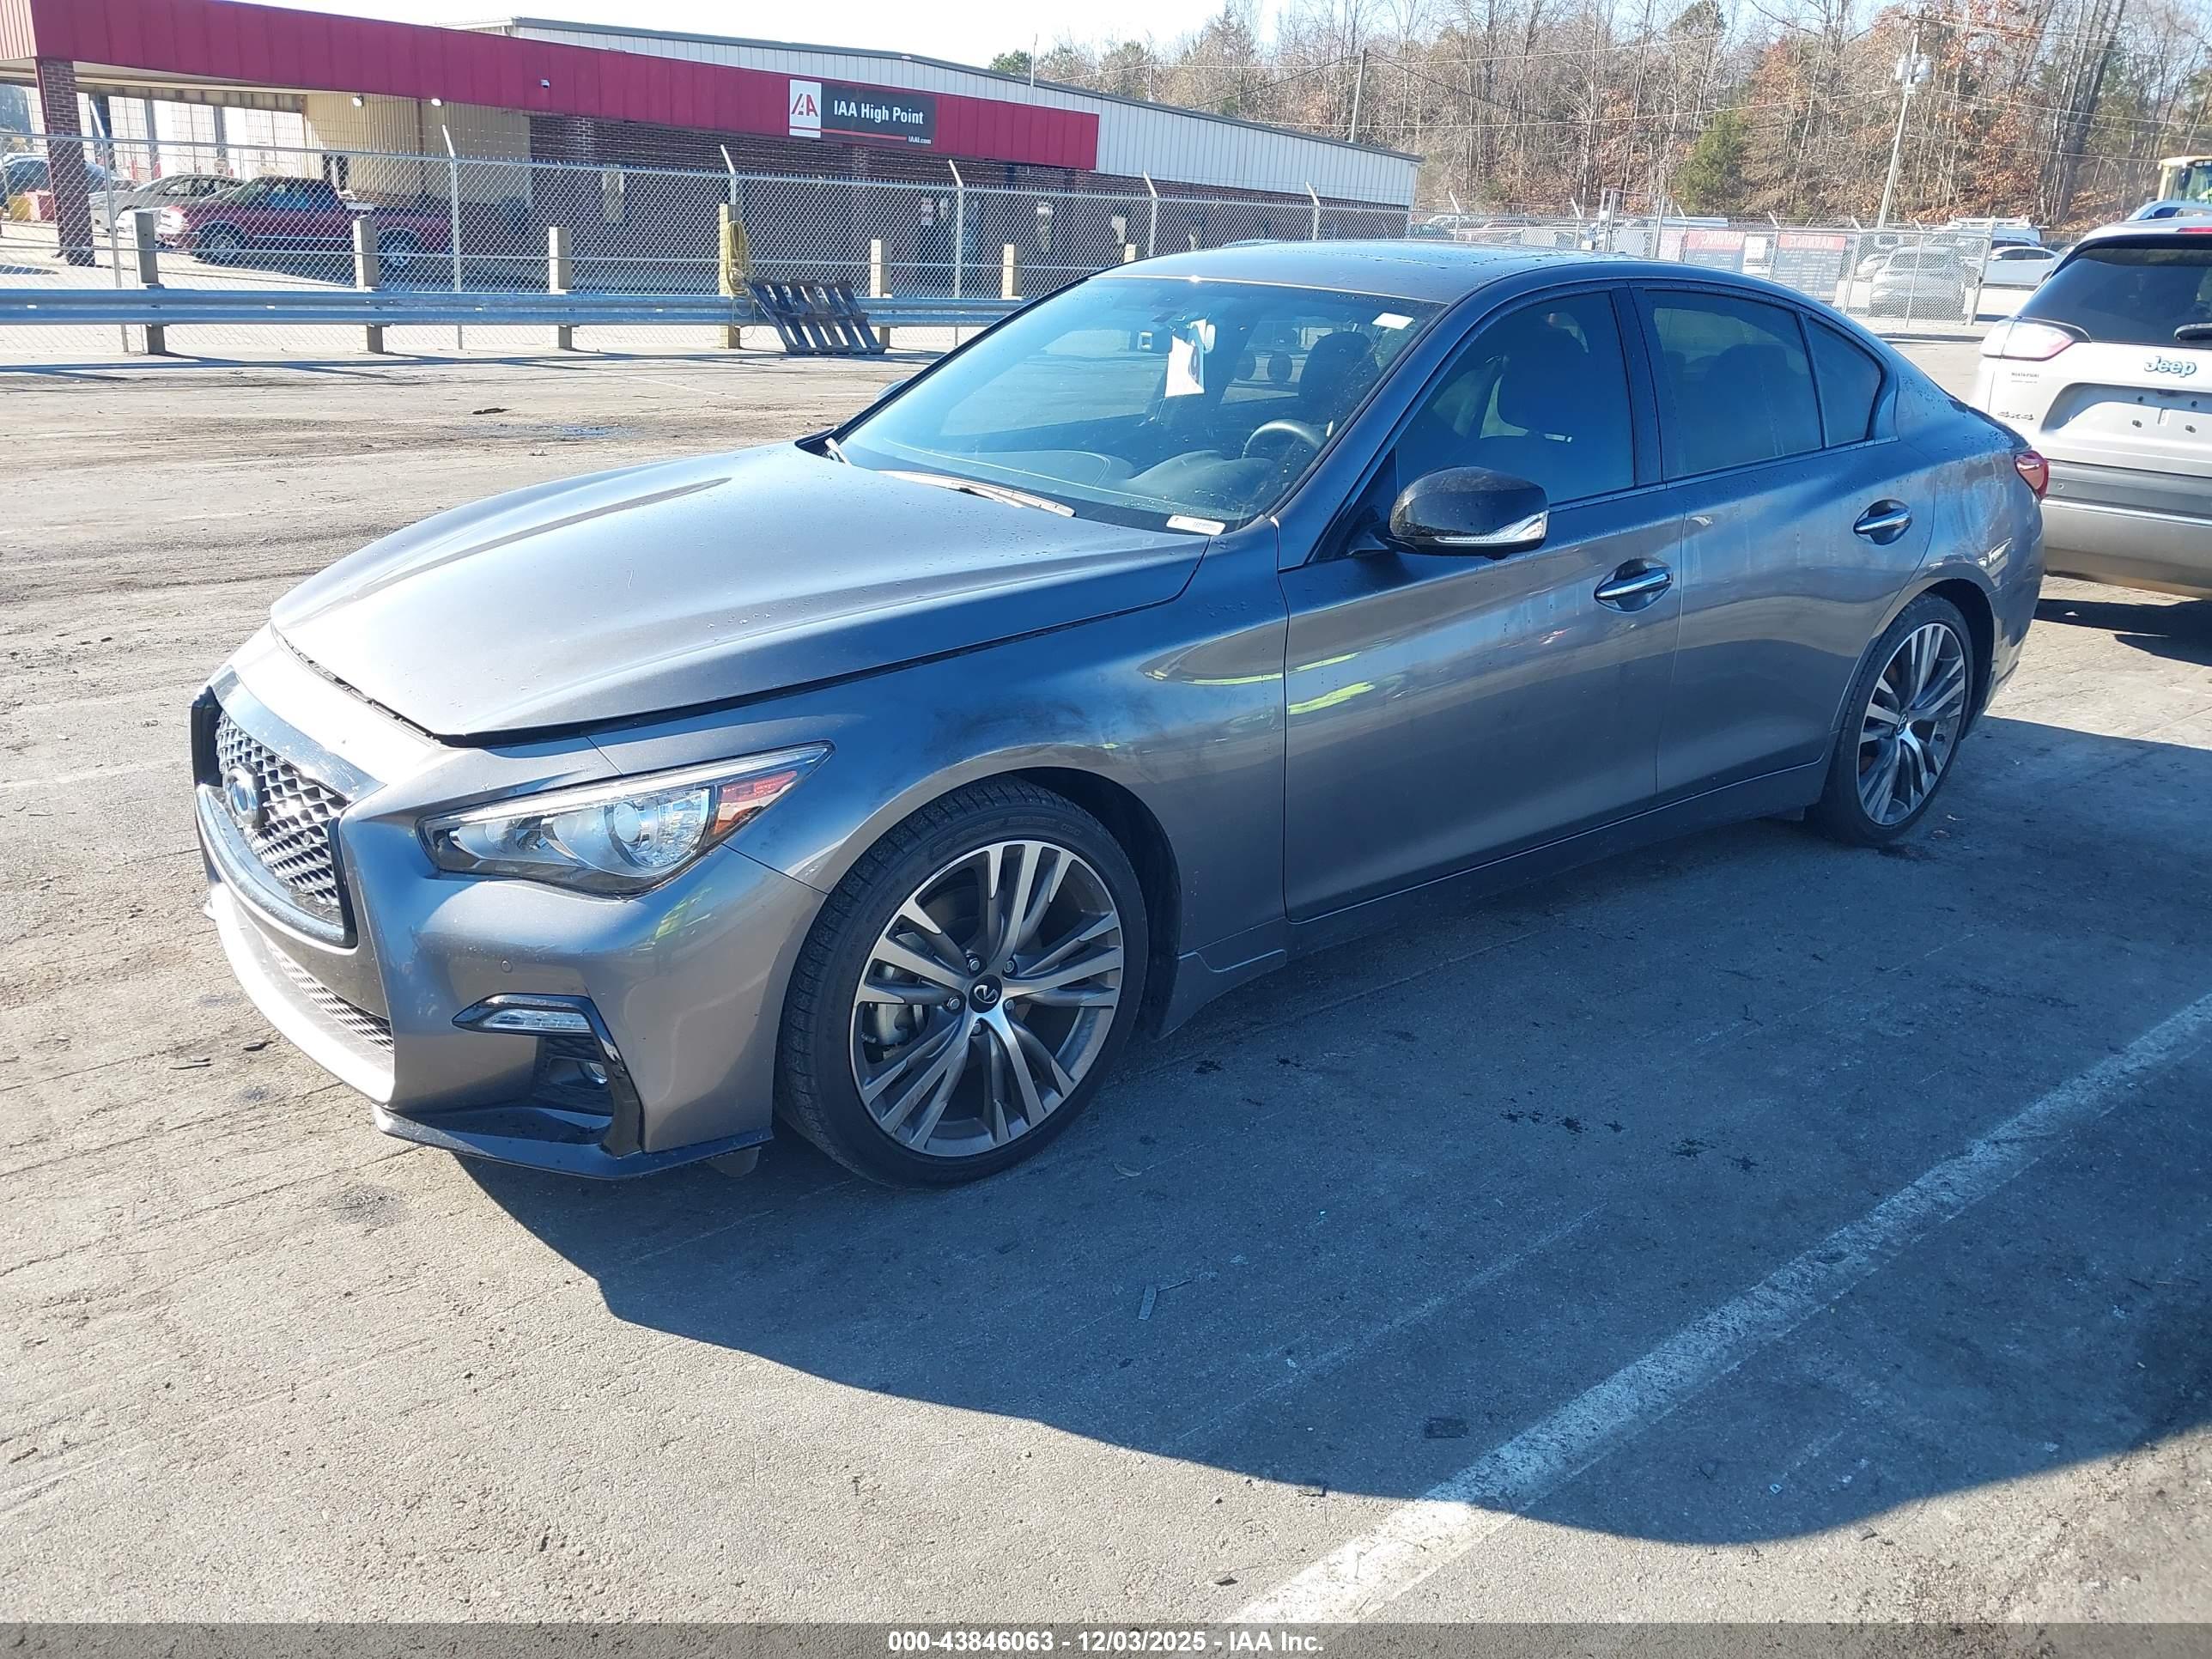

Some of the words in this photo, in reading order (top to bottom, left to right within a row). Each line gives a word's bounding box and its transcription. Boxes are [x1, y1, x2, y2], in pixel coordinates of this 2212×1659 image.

[834, 100, 858, 118] IAA
[860, 102, 889, 123] High
[892, 106, 924, 125] Point
[2144, 356, 2197, 378] Jeep
